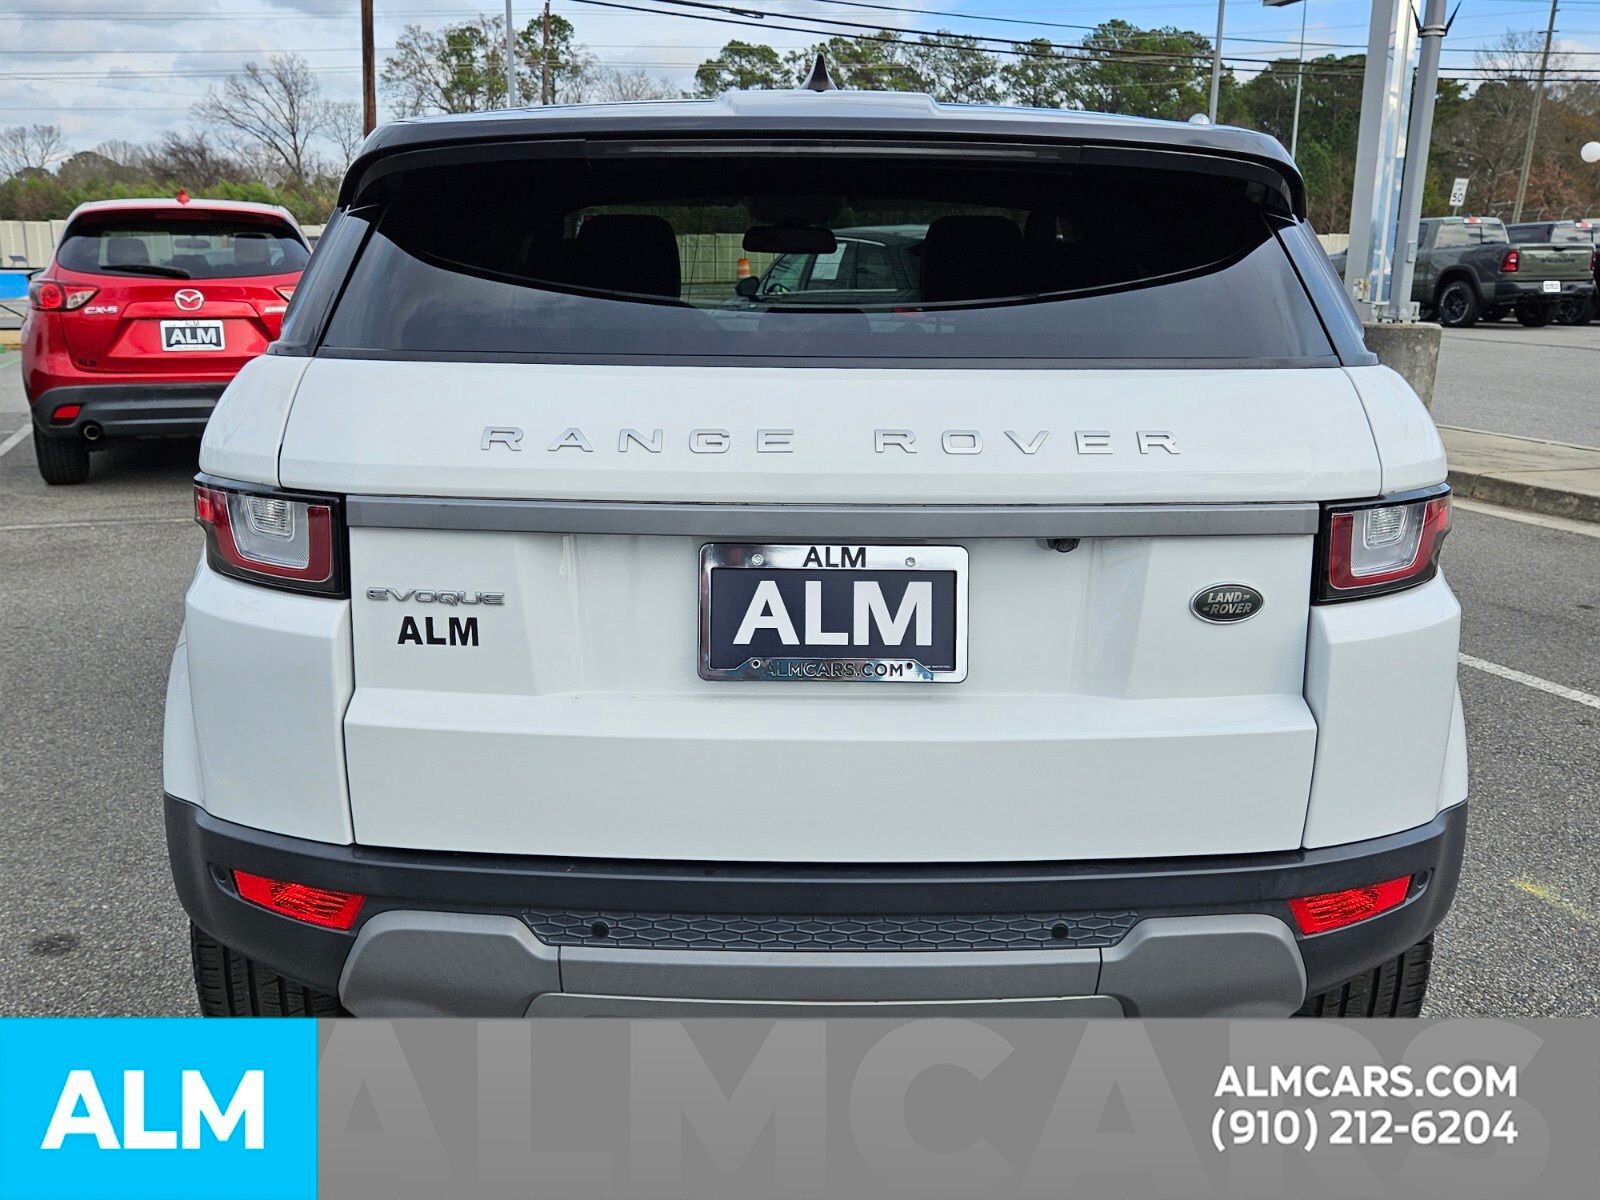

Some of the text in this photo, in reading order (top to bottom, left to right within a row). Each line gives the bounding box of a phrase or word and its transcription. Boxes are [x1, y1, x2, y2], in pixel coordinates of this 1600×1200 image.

[170, 328, 217, 344] ALM
[481, 426, 1182, 455] RANGE ROVER
[803, 546, 866, 568] ALM
[366, 587, 504, 606] EVOQUE
[1207, 592, 1242, 603] LAND
[733, 580, 932, 646] ALM
[1210, 603, 1252, 614] ROVER
[397, 616, 479, 646] ALM
[764, 662, 903, 677] ALMCARS.COM
